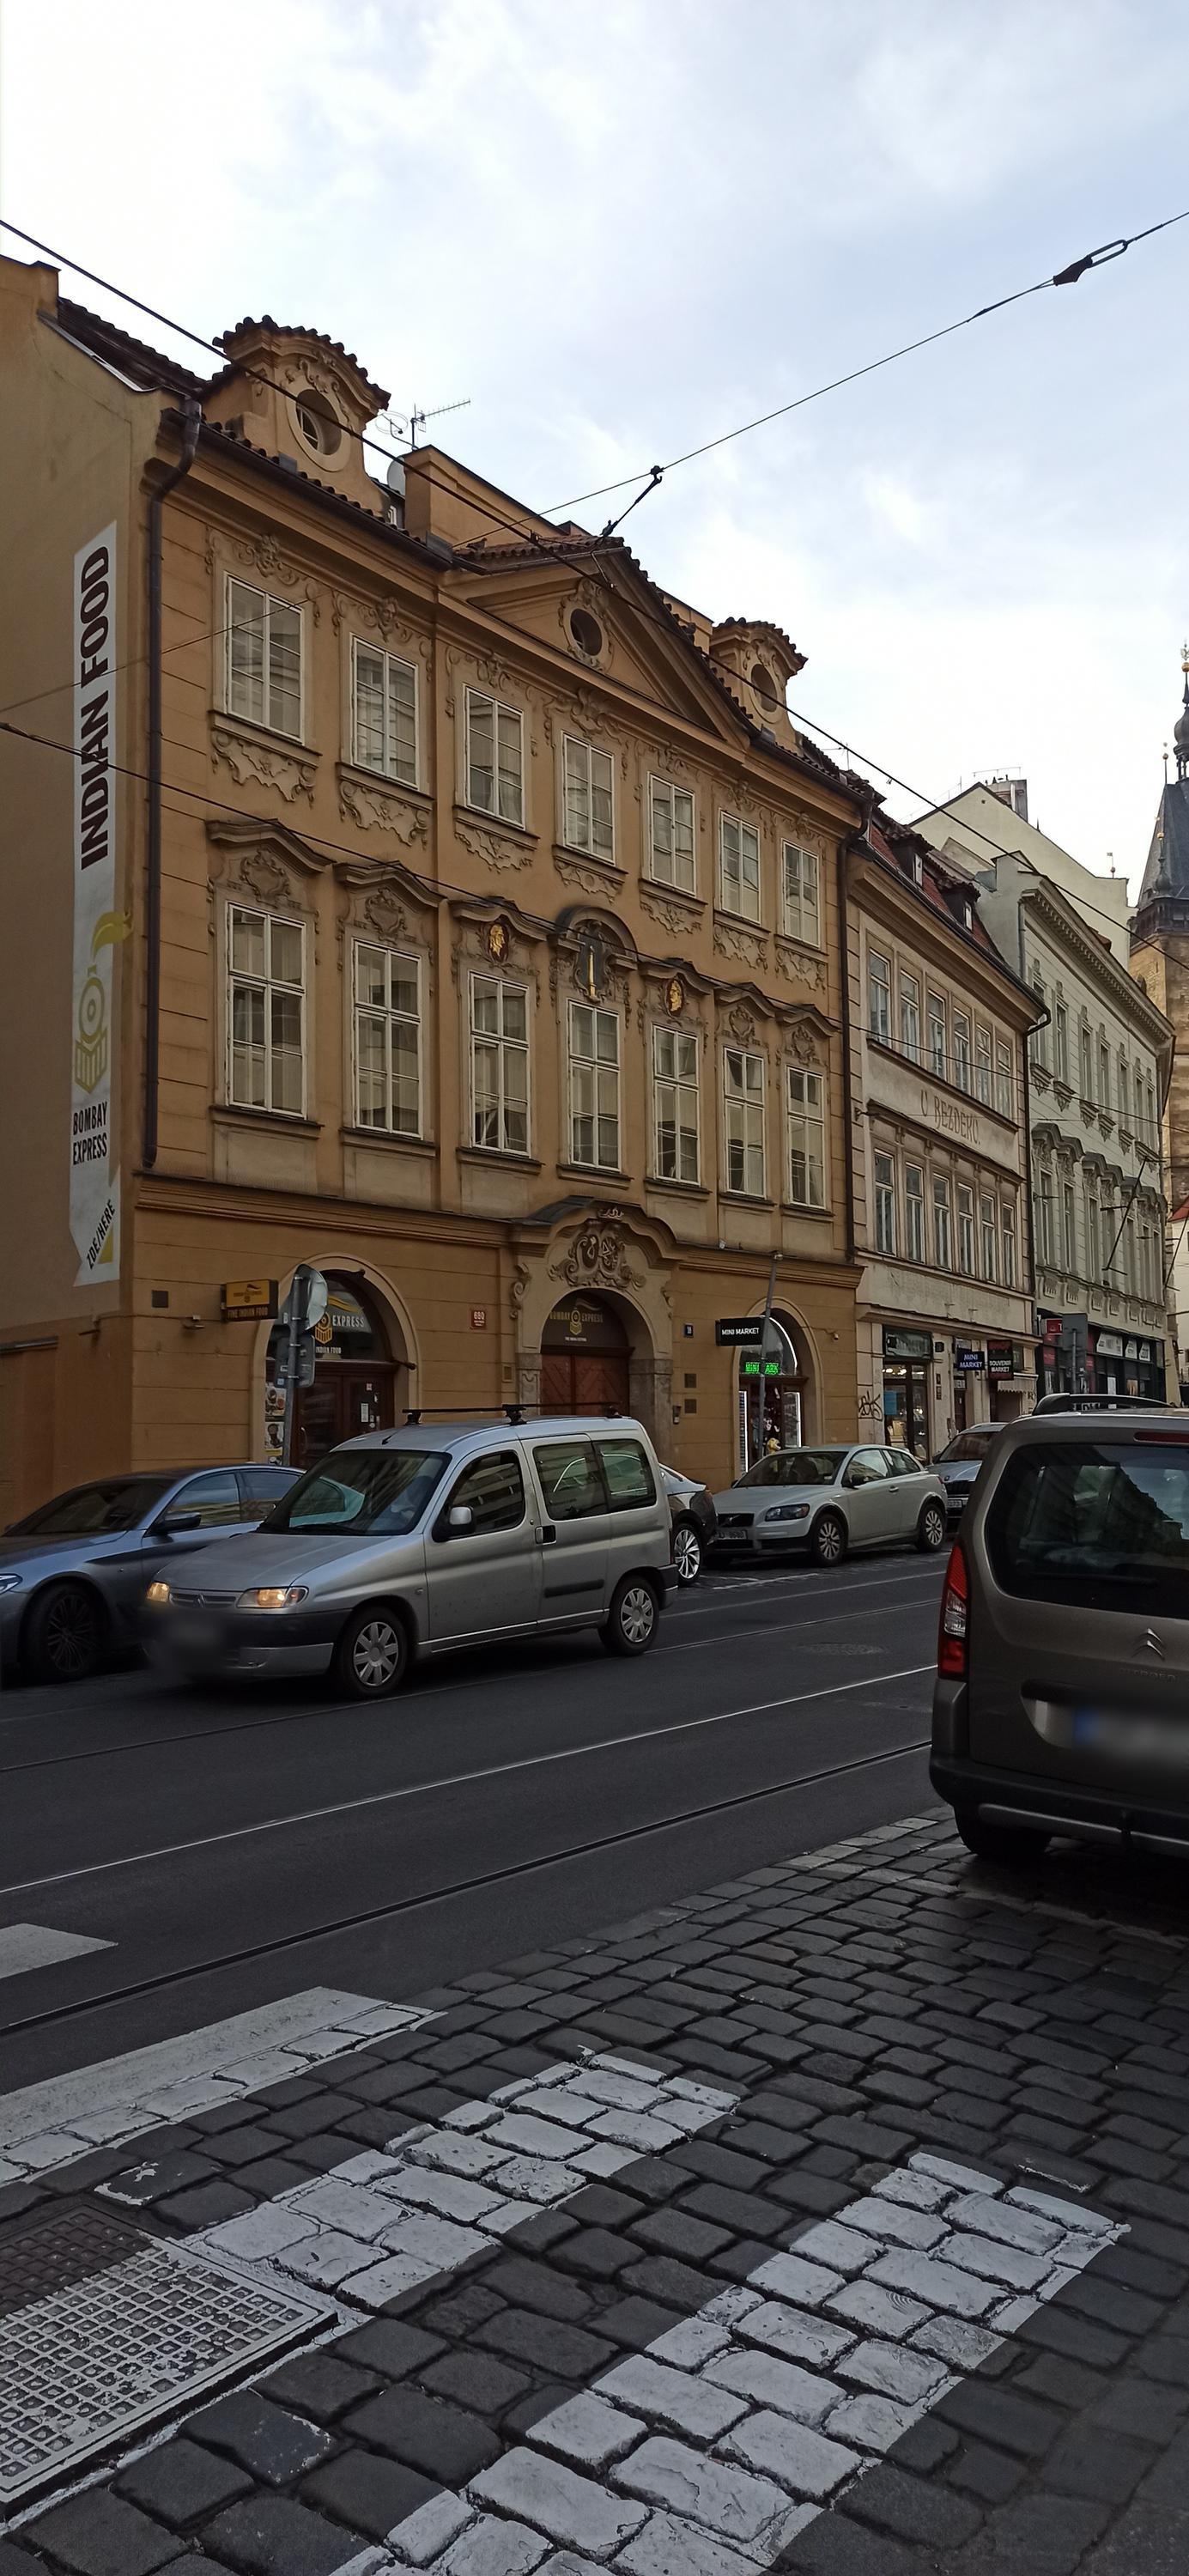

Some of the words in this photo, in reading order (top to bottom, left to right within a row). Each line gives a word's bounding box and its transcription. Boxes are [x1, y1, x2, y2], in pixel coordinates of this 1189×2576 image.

[80, 545, 109, 690] FOOD
[80, 690, 109, 871] INDIAN
[72, 1101, 107, 1136] BOMBAY
[920, 1089, 928, 1117] U
[72, 1136, 107, 1165] EXPRESS
[86, 1198, 116, 1271] ZDE/HERE
[332, 1315, 365, 1327] EXPRESS
